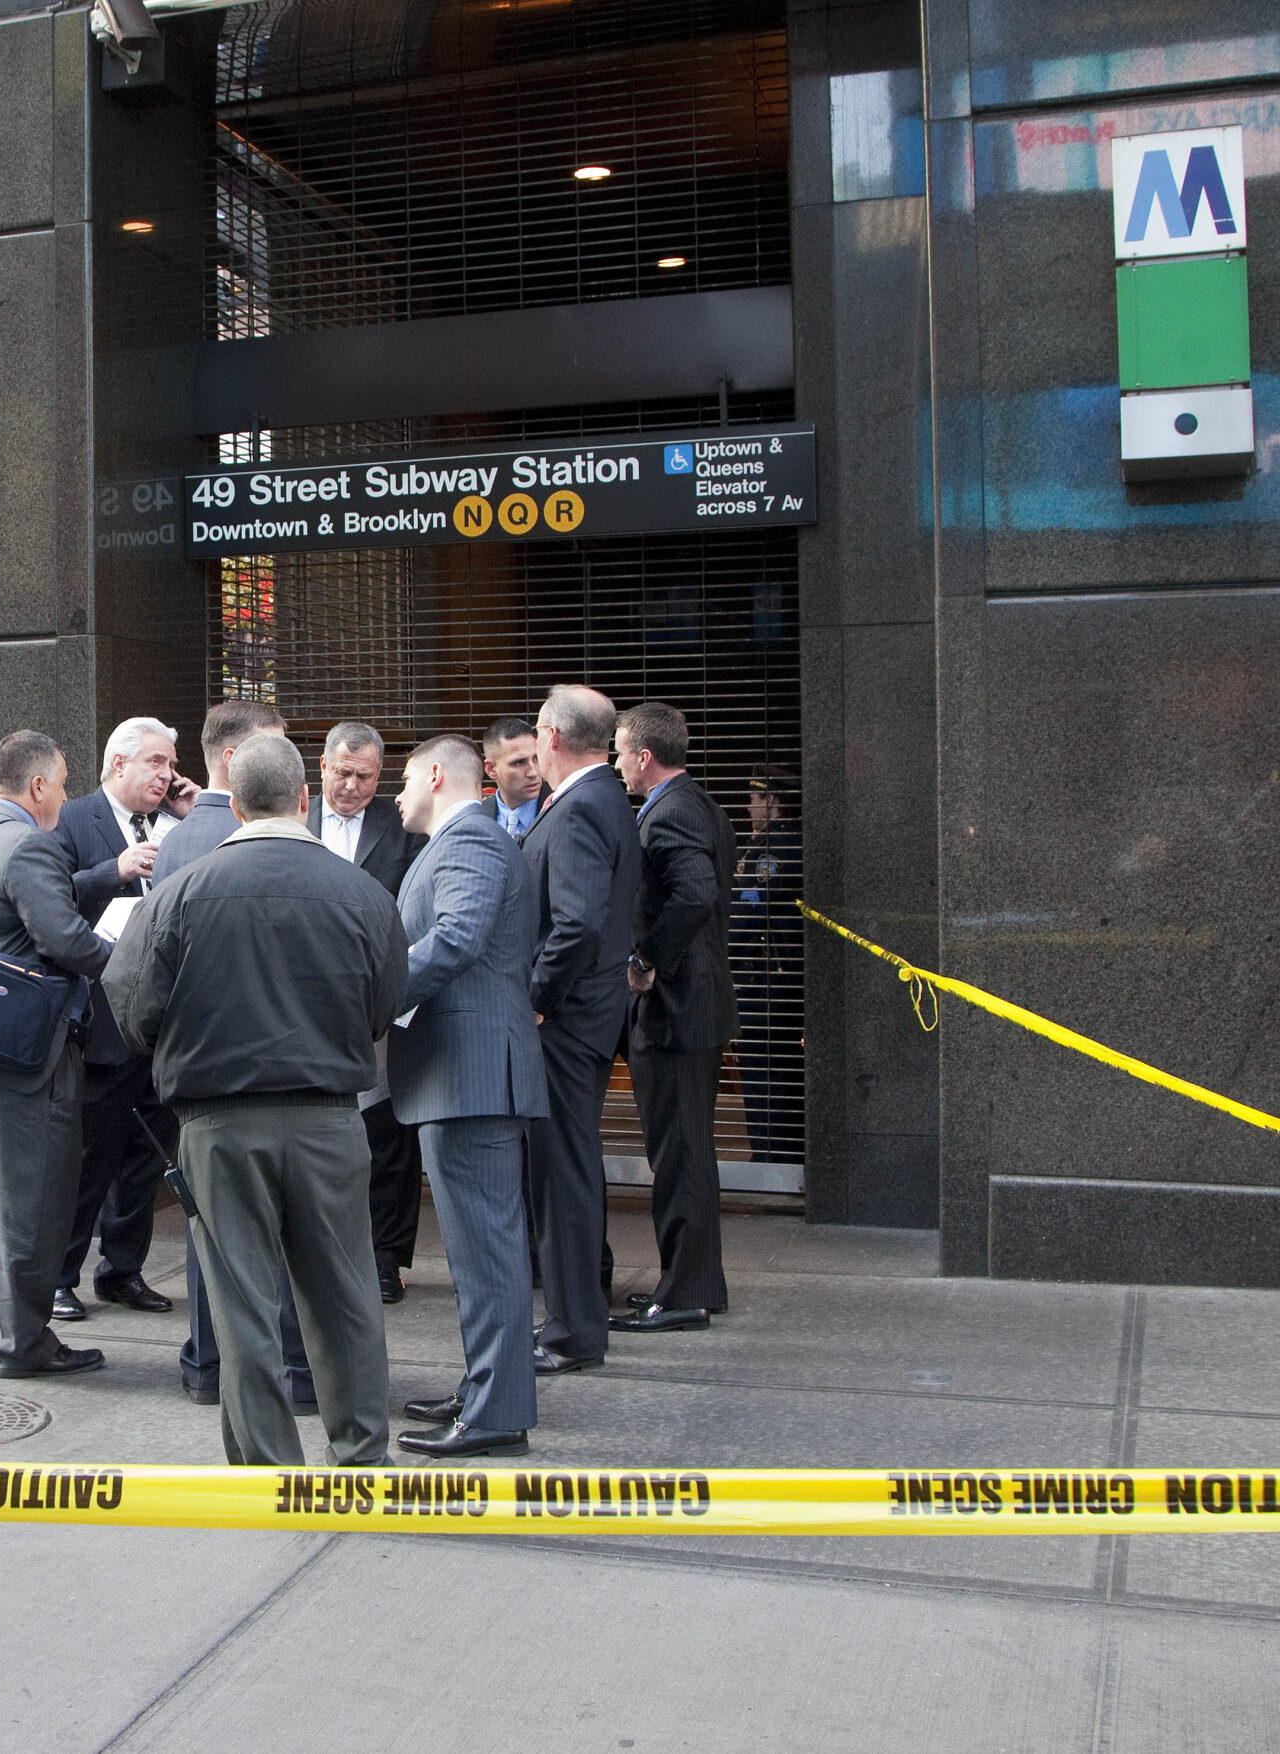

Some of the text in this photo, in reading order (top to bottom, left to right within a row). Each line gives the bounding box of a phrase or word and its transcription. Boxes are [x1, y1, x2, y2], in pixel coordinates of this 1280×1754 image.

[695, 437, 783, 460] Uptown &
[696, 461, 764, 477] Queens
[192, 452, 640, 508] 49 Street Subway Station
[696, 479, 767, 496] Elevator
[192, 500, 574, 542] Downtown & Brooklyn N Q R
[696, 494, 803, 515] across 7 Av
[276, 1470, 711, 1518] CAUTION CRIME SCENE
[887, 1472, 1003, 1517] SCENE
[1013, 1472, 1135, 1516] CRIME
